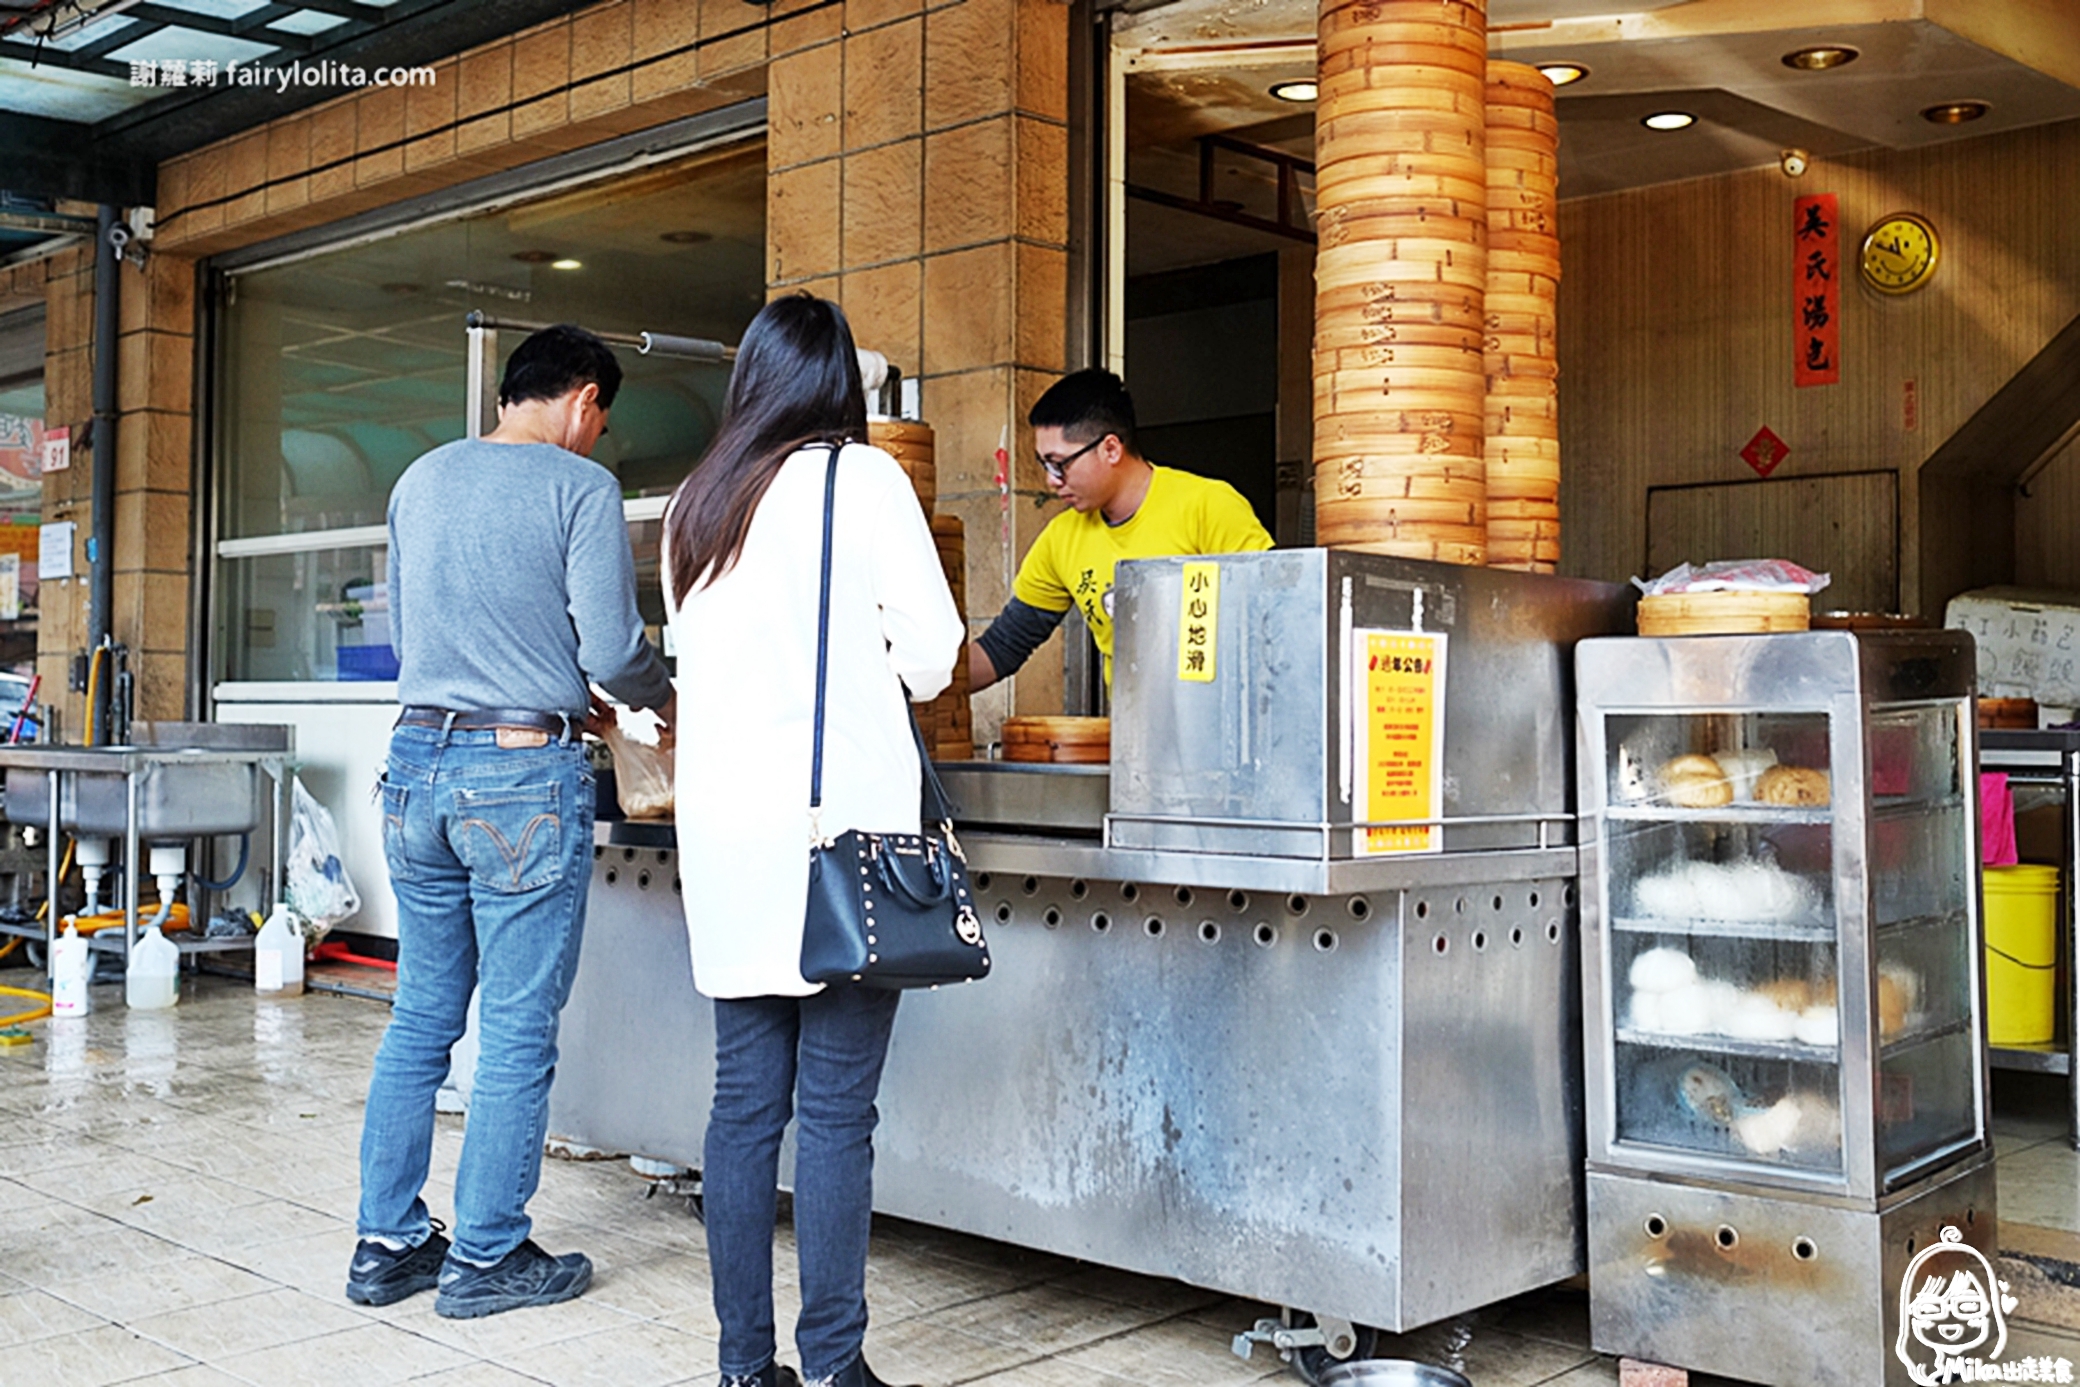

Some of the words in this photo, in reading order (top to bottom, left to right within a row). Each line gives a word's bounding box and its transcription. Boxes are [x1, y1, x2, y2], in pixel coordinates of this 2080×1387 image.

[51, 446, 65, 467] 91
[1186, 571, 1210, 673] 小心地滑
